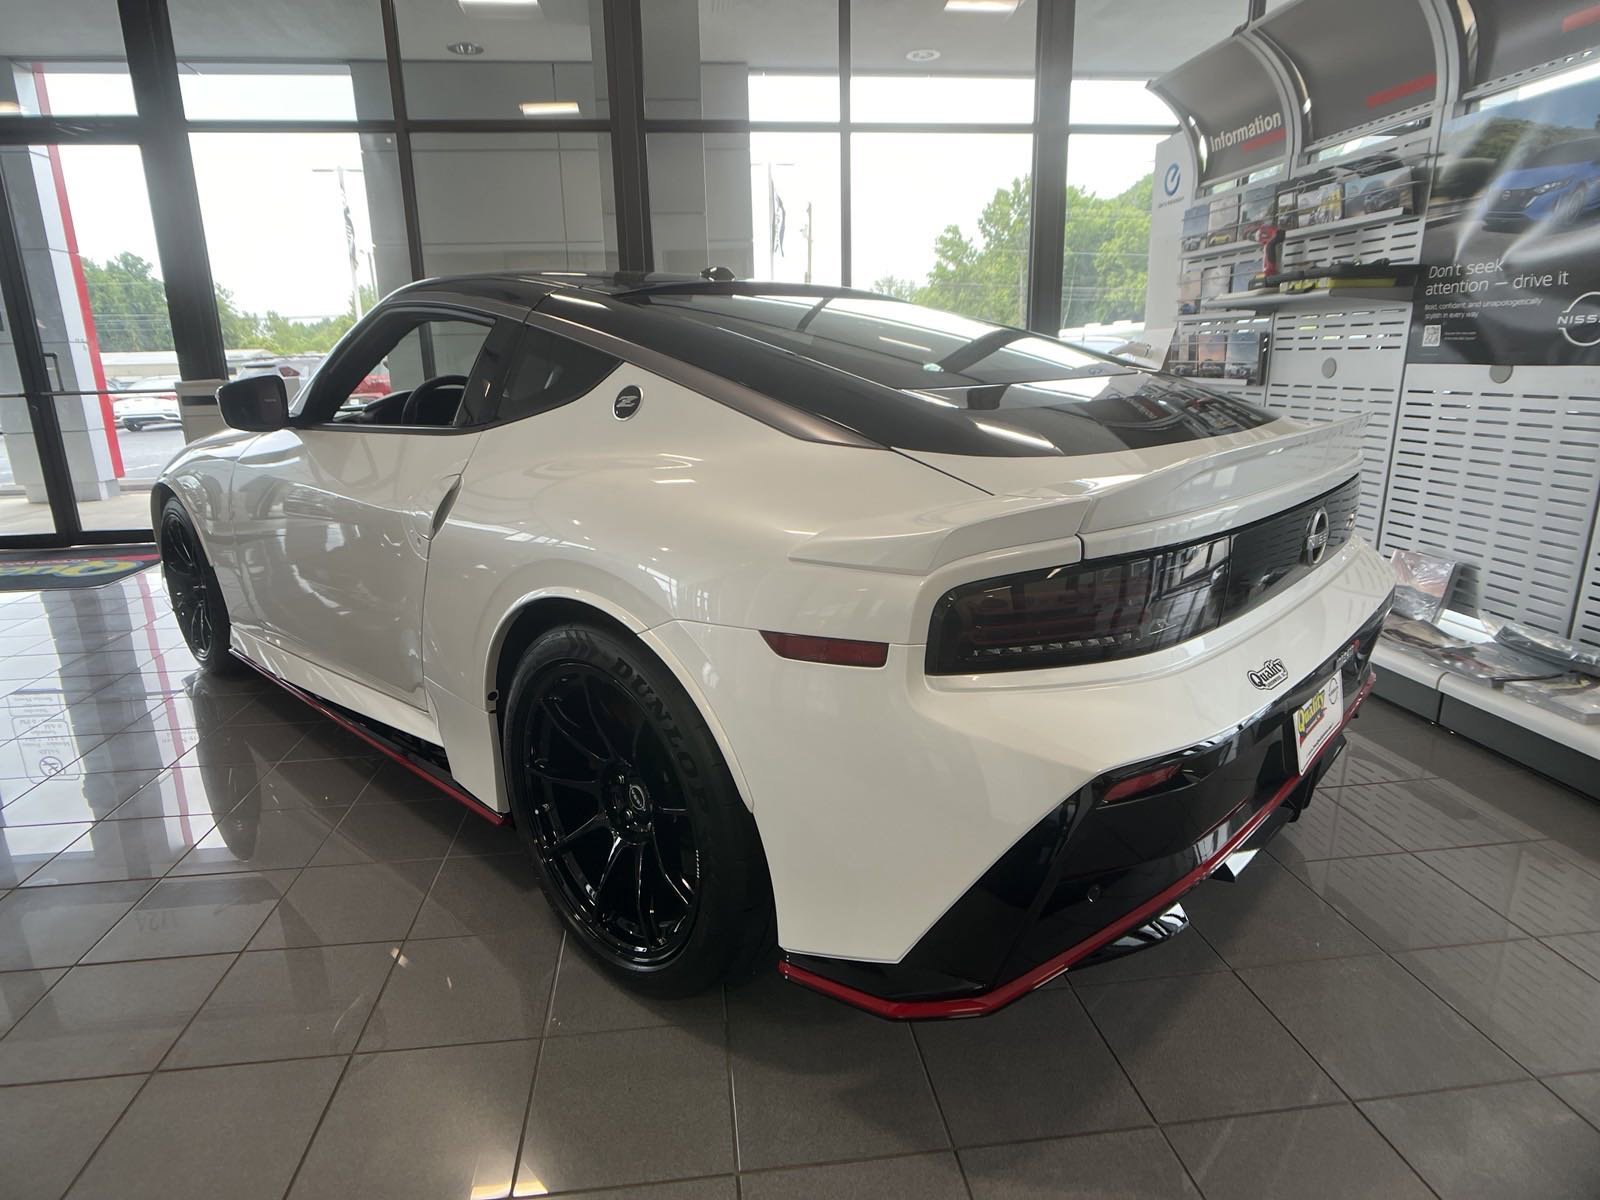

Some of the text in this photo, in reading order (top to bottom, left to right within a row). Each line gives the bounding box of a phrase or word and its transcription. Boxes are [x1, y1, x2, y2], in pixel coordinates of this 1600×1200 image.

[1210, 112, 1282, 152] Information
[1428, 258, 1504, 279] Don't seek
[1425, 279, 1489, 296] attention
[1513, 274, 1552, 289] drive
[1558, 271, 1569, 286] it
[1556, 314, 1600, 325] NISS
[1249, 659, 1284, 688] Quality
[1297, 690, 1325, 734] Quality
